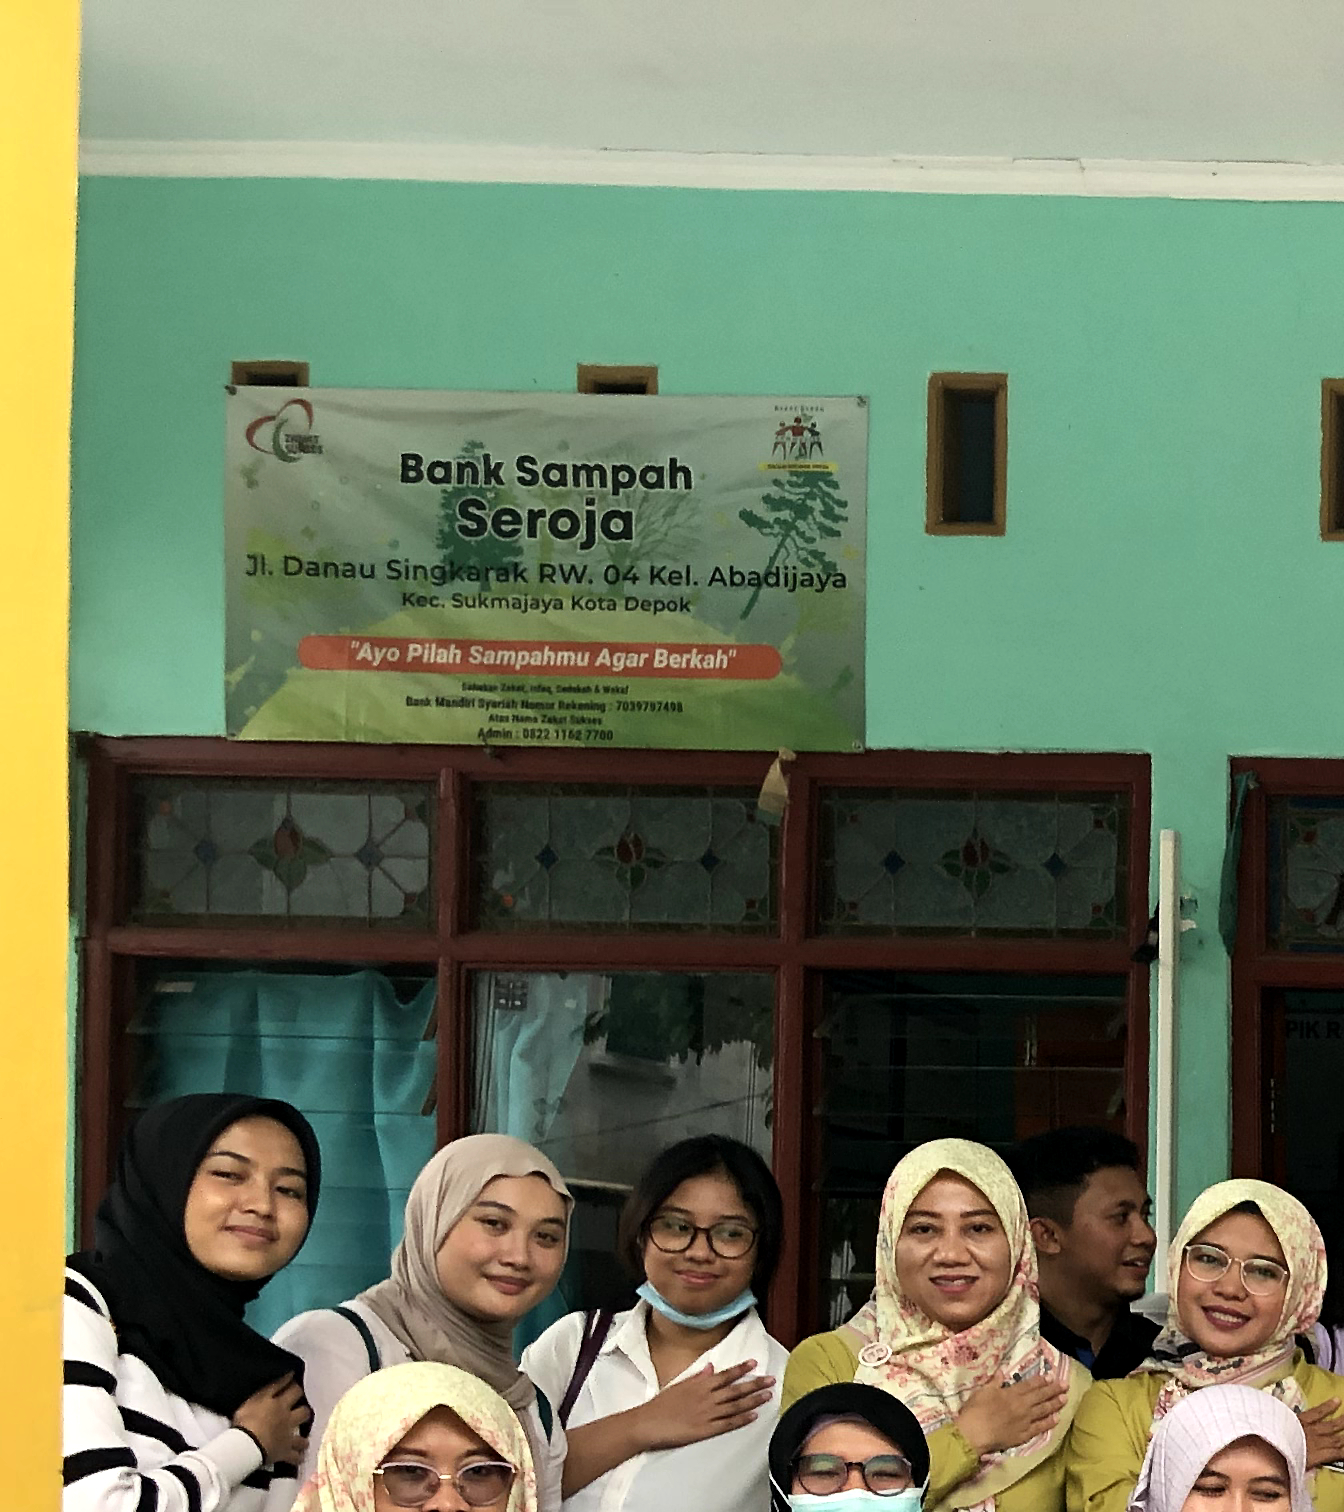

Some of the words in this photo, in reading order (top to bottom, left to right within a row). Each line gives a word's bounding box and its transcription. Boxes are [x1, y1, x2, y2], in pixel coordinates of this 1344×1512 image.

[400, 454, 504, 487] Bank
[516, 456, 693, 496] Sampah
[457, 499, 635, 549] Seroja
[246, 554, 274, 577] Jl.
[283, 556, 377, 581] Danau
[386, 559, 528, 587] Singkarak
[539, 563, 594, 586] RW.
[603, 564, 640, 586] 04
[648, 563, 700, 588] Kel.
[707, 565, 848, 592] Abadijaya
[402, 593, 446, 610] Kec.
[451, 594, 564, 614] Sukmajaya
[572, 595, 621, 612] Kota
[625, 597, 691, 616] Depok
[350, 641, 401, 665] "Ayo
[406, 643, 463, 665] Pilah
[468, 646, 590, 670] Sampahmu
[594, 648, 648, 672] Agar
[654, 647, 737, 670] Berkah"
[558, 701, 606, 713] Rekening
[478, 727, 513, 740] Admin
[523, 728, 551, 740] 0822
[584, 730, 614, 741] 7700
[1326, 1021, 1342, 1040] R
